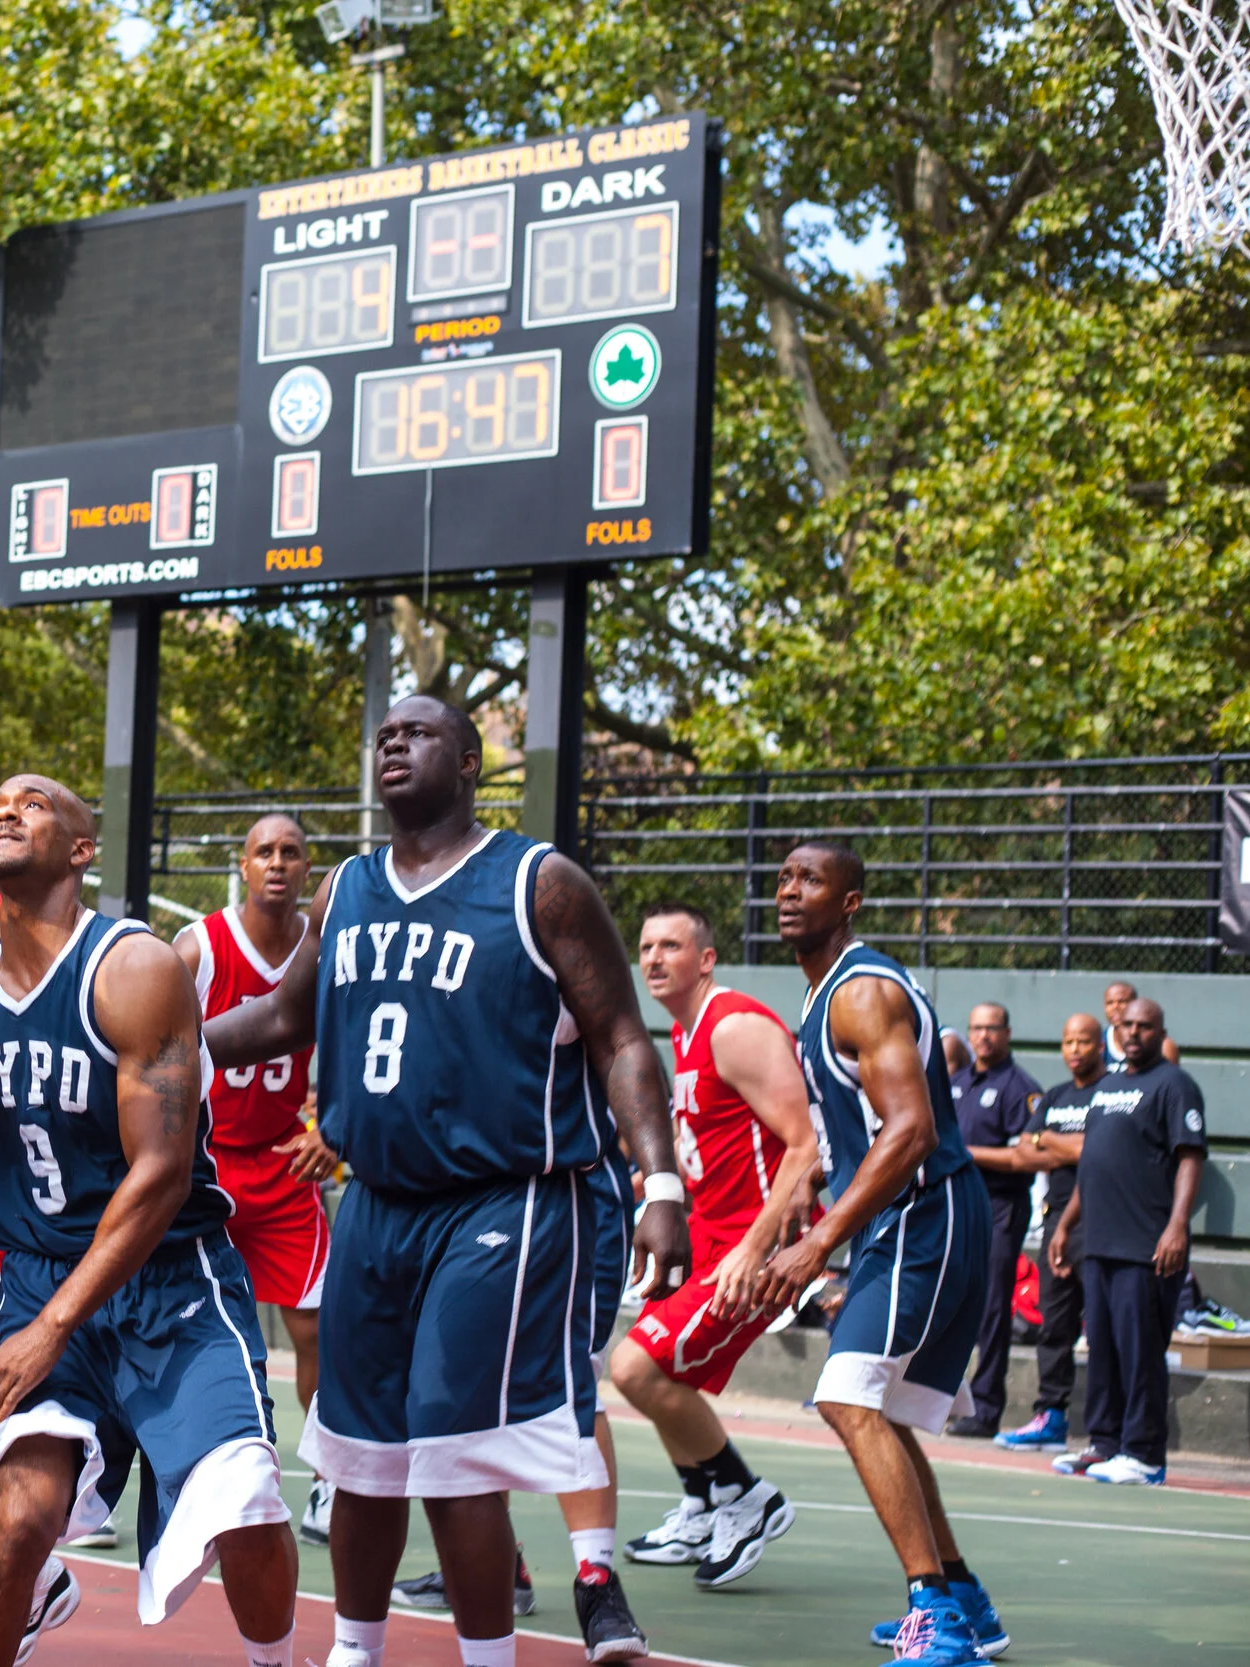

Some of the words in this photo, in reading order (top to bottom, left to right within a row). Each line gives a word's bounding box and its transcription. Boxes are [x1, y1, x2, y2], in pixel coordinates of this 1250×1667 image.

[428, 136, 582, 191] BASKETBALL
[587, 120, 690, 166] CLASSIC
[541, 164, 666, 212] DARK
[273, 209, 389, 254] LIGHT
[414, 316, 501, 344] PERIOD
[14, 489, 29, 557] LIGHT
[69, 506, 107, 529] TIME
[108, 501, 151, 526] OUTS
[194, 471, 213, 538] DARK
[585, 518, 652, 546] FOULS
[20, 556, 199, 592] EBCSPORTS.COM
[265, 545, 323, 571] FOULS
[334, 921, 476, 992] NYPD
[362, 1002, 409, 1094] 8
[19, 1123, 67, 1215] 9
